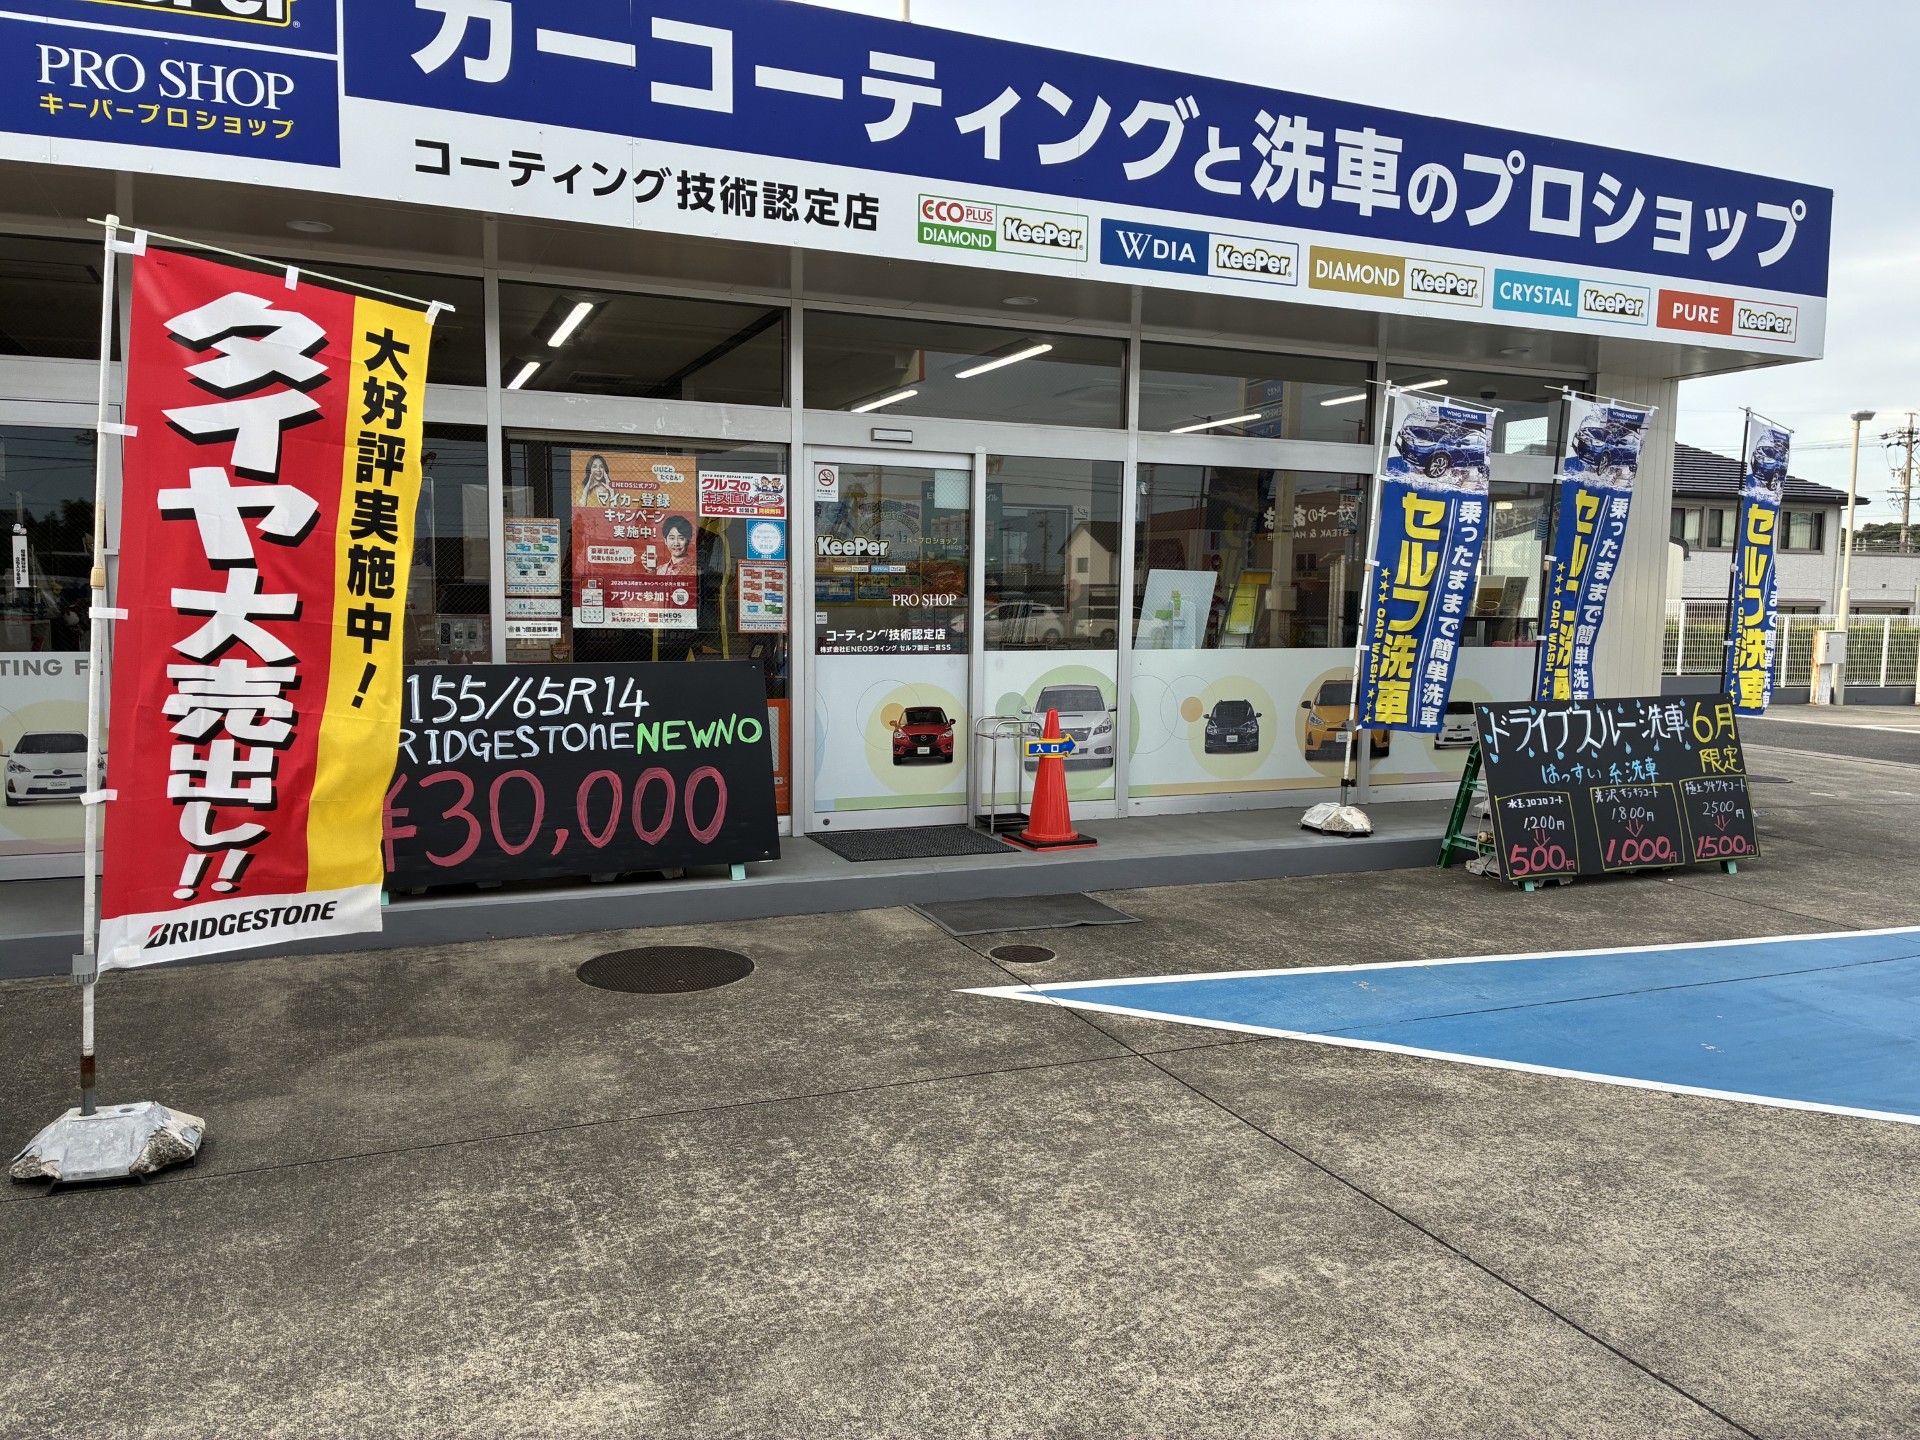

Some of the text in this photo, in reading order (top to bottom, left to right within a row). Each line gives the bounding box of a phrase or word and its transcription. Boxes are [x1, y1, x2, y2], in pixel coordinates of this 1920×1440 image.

[36, 44, 296, 112] PRO SHOP
[38, 92, 296, 140] キーパープロショップ
[412, 0, 1807, 268] カーコーティングと洗車のプロショップ
[414, 138, 880, 232] コーティング技術認定店
[922, 199, 994, 224] ECO PLUS
[922, 225, 993, 249] DIAMOND
[1003, 216, 1082, 250] KeePer
[1215, 242, 1292, 277] KeePer
[1315, 258, 1400, 288] DIAMOND
[1410, 267, 1479, 298] KeePer
[1499, 279, 1573, 309] CRYSTAL
[1583, 289, 1644, 317] KeePer
[1672, 302, 1719, 325] PURE
[1737, 309, 1791, 336] KeePer
[701, 478, 751, 492] クルマの
[702, 490, 755, 506] キズ直し
[597, 492, 671, 508] マイカー登録
[346, 327, 411, 709] 大好評実施中!
[604, 508, 666, 523] キャンペーン
[613, 525, 657, 539] 実施中!
[815, 535, 889, 557] KeePer
[610, 591, 669, 602] アプリで参加!
[892, 593, 957, 607] PRO SHOP
[1374, 491, 1446, 725] セルフ洗車
[1420, 500, 1482, 728] 乗ったままで簡単洗車
[826, 628, 946, 642] コーティング技術認定店
[1368, 607, 1387, 685] CAR WASH
[1544, 599, 1562, 672] CAR WASH
[407, 674, 650, 724] 155/65R14
[1489, 704, 1687, 754] ドライブスルー洗車
[1692, 702, 1736, 743] 6月
[1036, 744, 1060, 753] 入口
[1698, 745, 1746, 774] 限定
[1541, 763, 1602, 785] はっすい
[1523, 815, 1565, 831] 1,200円
[1509, 843, 1576, 876] 500円
[1605, 836, 1677, 865] 1,000円
[143, 900, 338, 950] BRIDGESTONE
